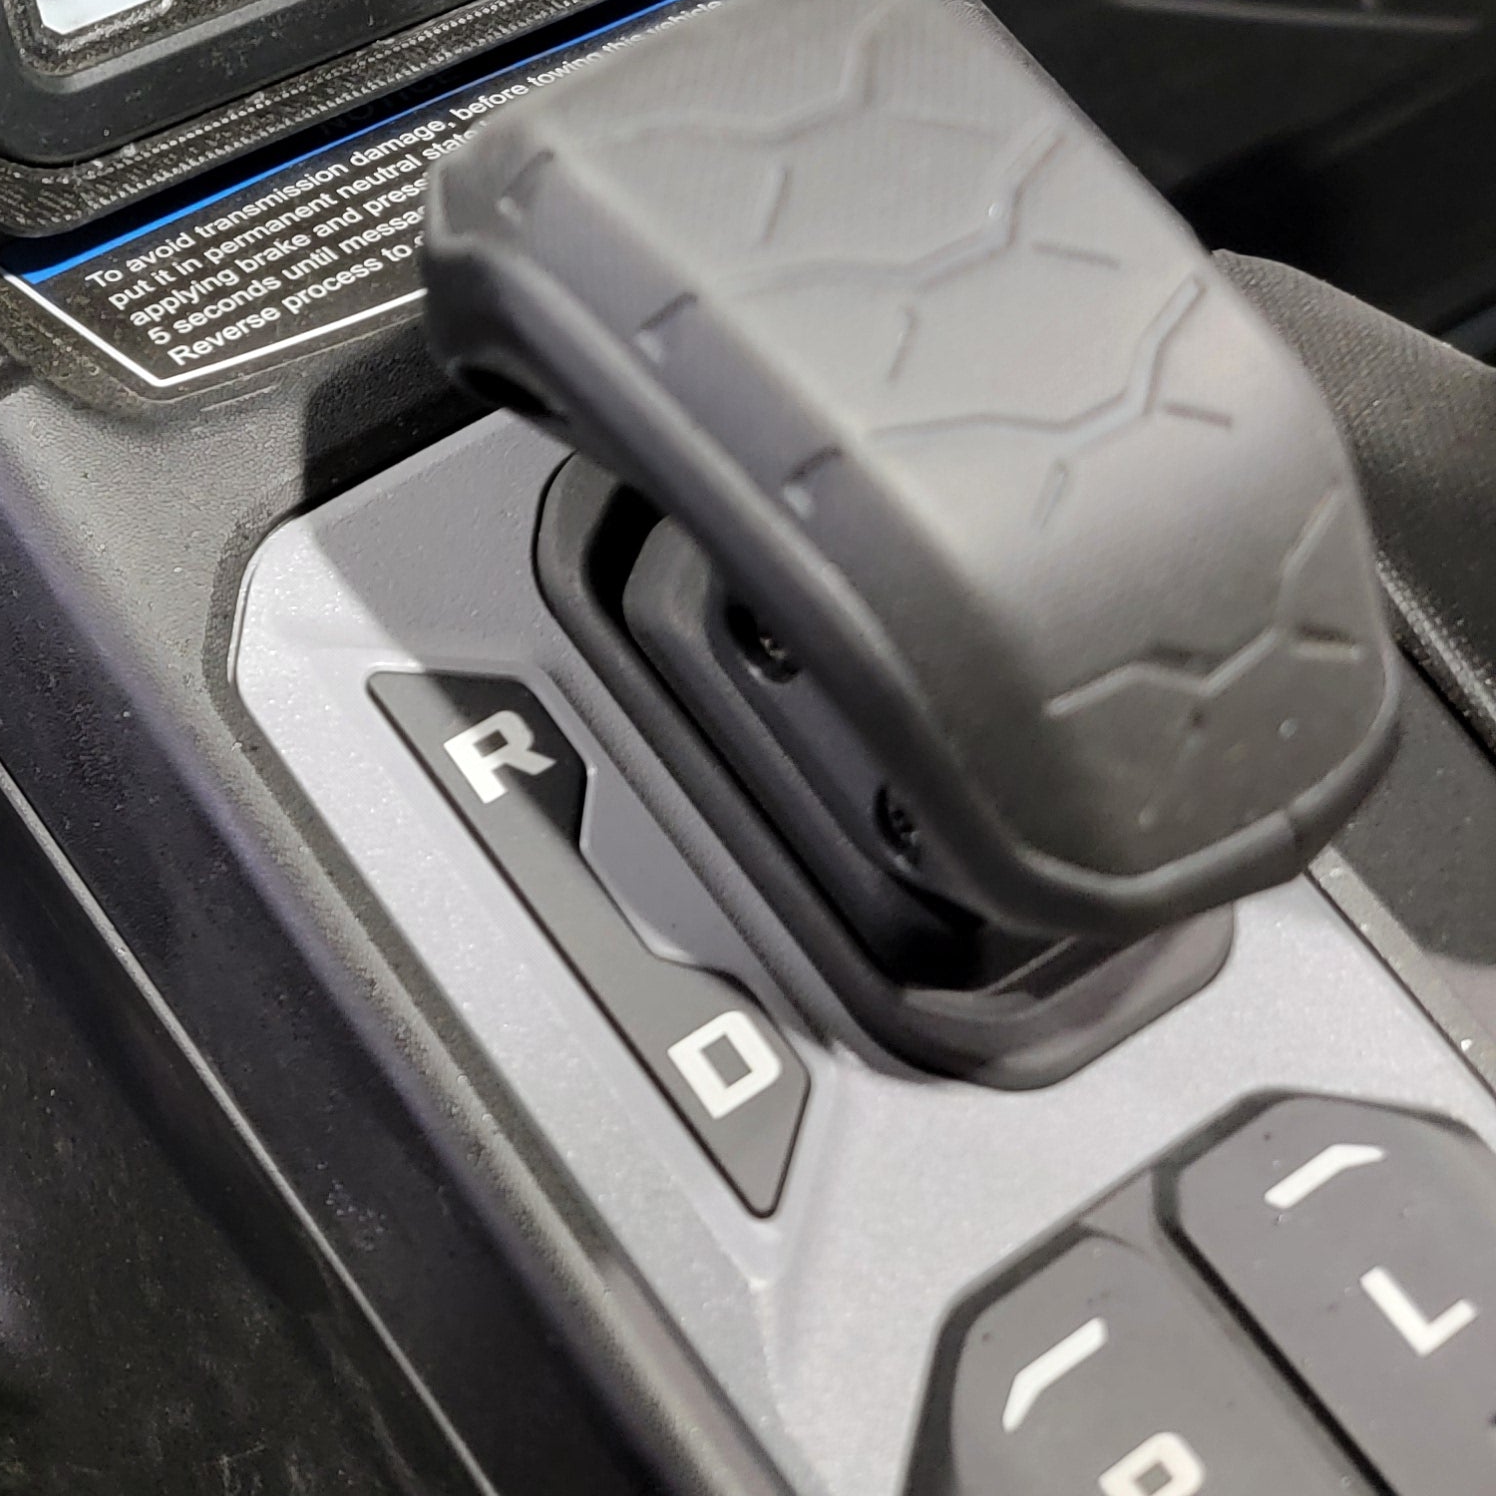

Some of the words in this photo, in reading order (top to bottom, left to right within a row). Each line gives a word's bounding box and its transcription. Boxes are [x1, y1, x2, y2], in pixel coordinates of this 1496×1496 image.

[85, 269, 123, 287] To
[126, 232, 196, 272] avoid
[194, 163, 349, 239] transmission
[350, 120, 456, 167] damage,
[449, 83, 529, 121] before
[108, 279, 156, 311] put
[151, 269, 178, 285] it
[172, 258, 203, 276] in
[203, 192, 338, 265] permanent
[336, 153, 422, 199] neutral
[130, 269, 240, 327] applying
[234, 232, 312, 274] brake
[312, 207, 363, 238] and
[147, 326, 171, 345] 5
[173, 275, 282, 335] seconds
[281, 246, 340, 281] until
[167, 306, 281, 366] Reverse
[281, 257, 384, 315] process
[381, 243, 413, 262] to
[443, 709, 556, 803] R
[666, 1010, 783, 1119] D
[1359, 1265, 1480, 1357] L
